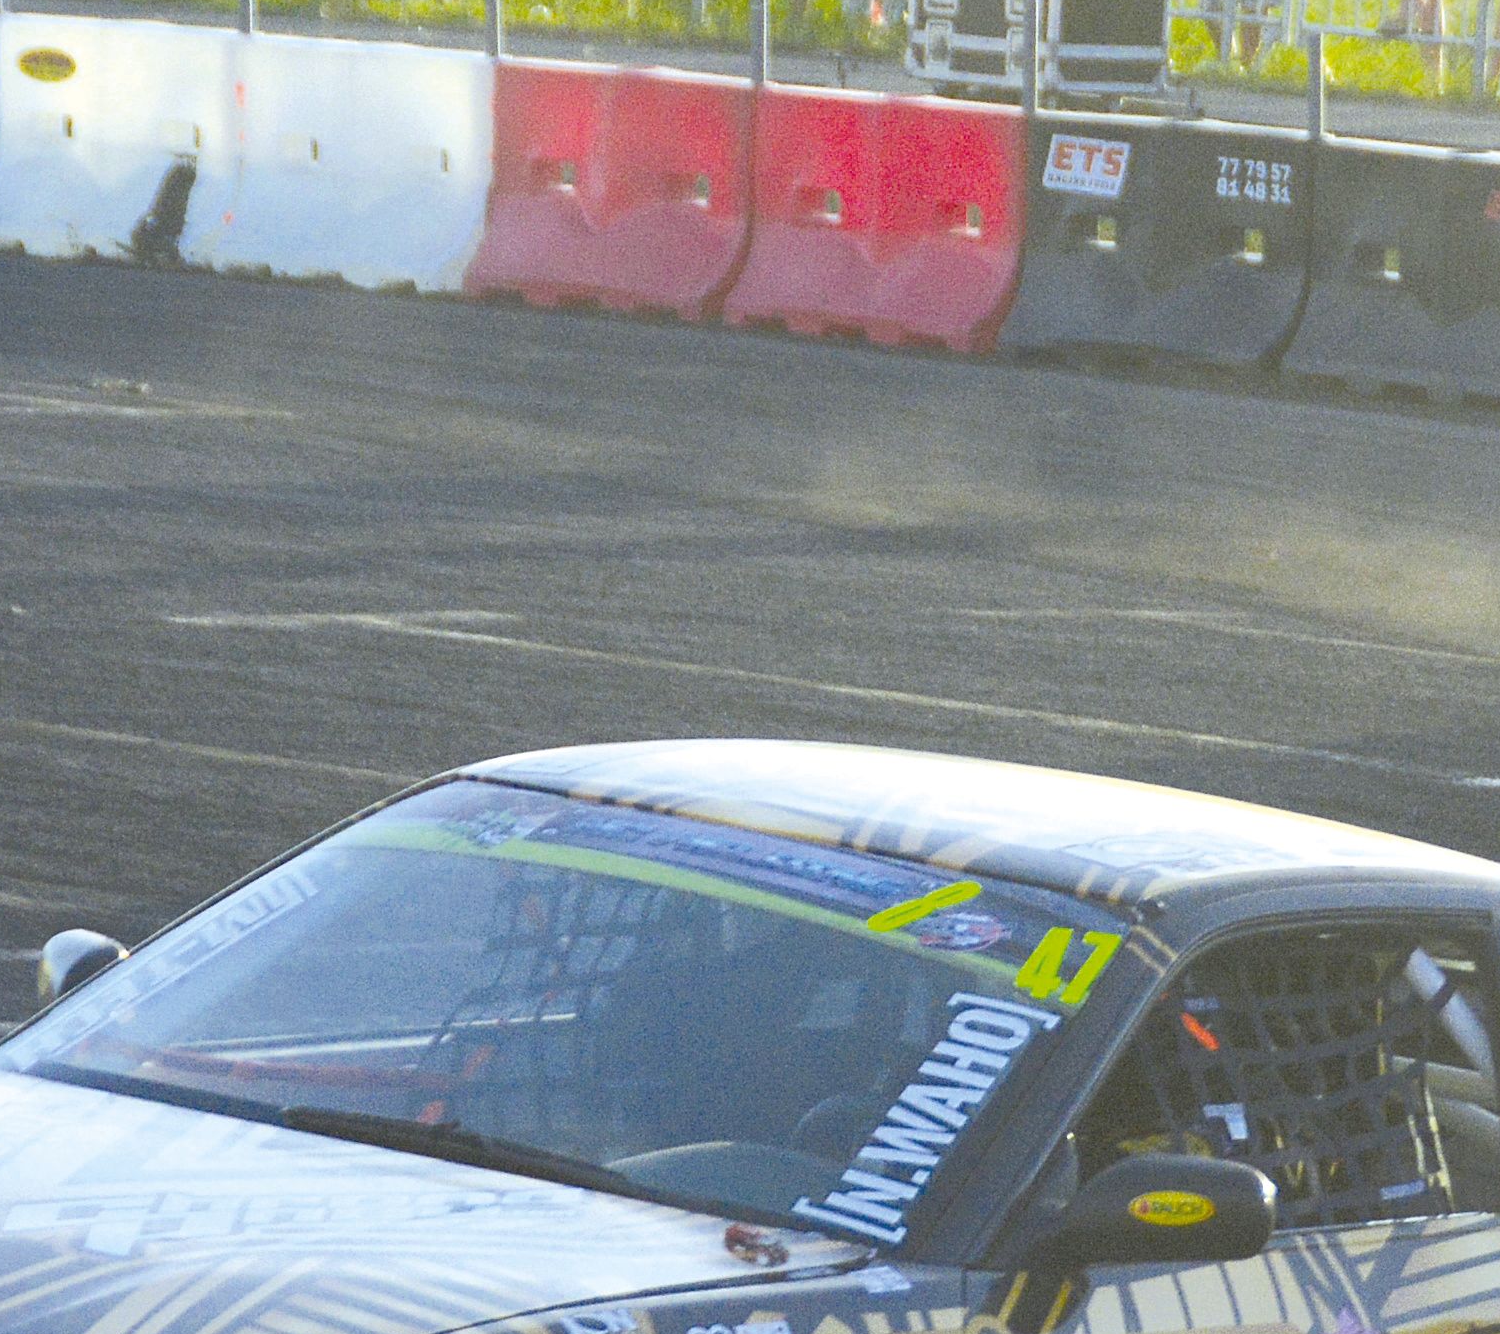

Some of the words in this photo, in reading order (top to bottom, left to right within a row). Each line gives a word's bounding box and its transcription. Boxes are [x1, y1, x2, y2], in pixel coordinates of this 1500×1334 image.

[1050, 141, 1127, 179] ETS
[1217, 156, 1239, 175] 77
[1243, 159, 1268, 179] 79
[1271, 163, 1293, 182] 57
[1215, 176, 1240, 198] 81
[1243, 180, 1268, 203] 48
[1270, 183, 1293, 205] 31
[1015, 925, 1123, 1006] 47
[791, 991, 1063, 1245] [N.WAHO]
